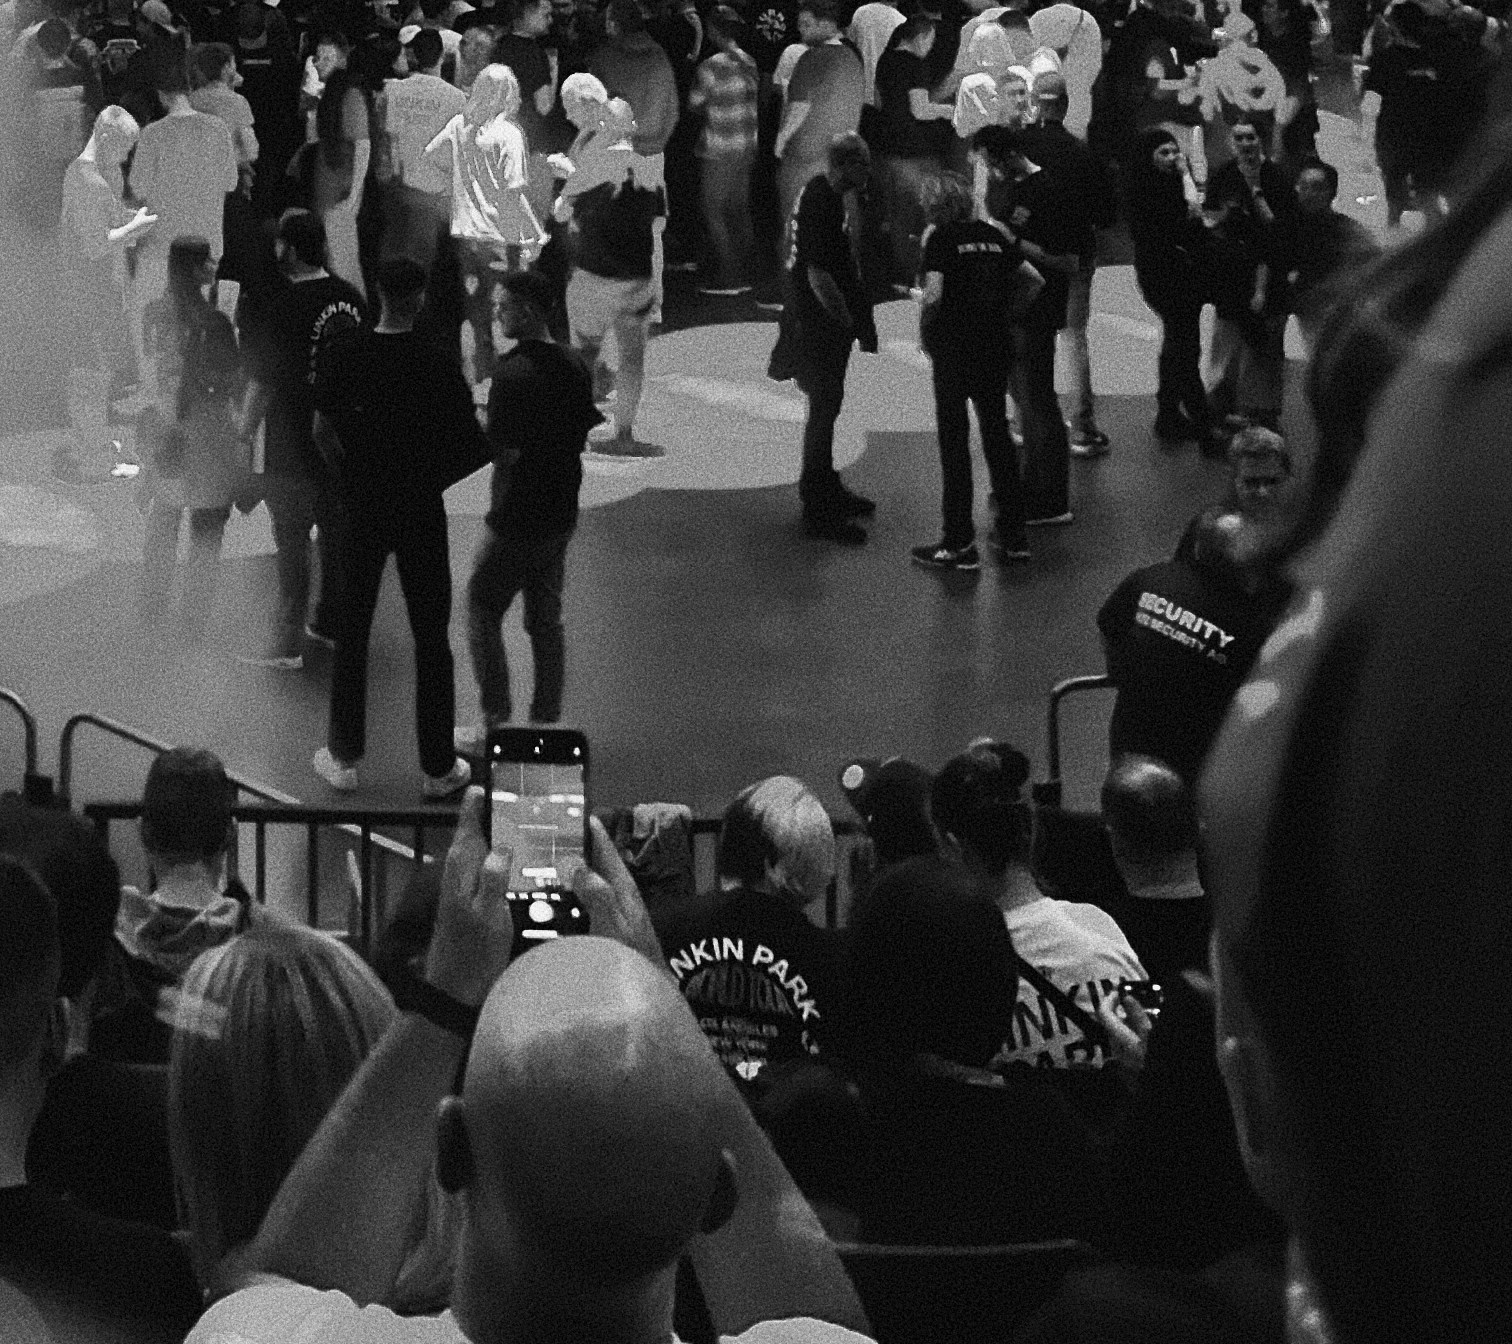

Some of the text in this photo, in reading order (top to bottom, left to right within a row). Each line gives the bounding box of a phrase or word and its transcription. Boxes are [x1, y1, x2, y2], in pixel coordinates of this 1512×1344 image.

[1138, 592, 1235, 648] SECURITY
[670, 937, 821, 1022] NKIN PARK
